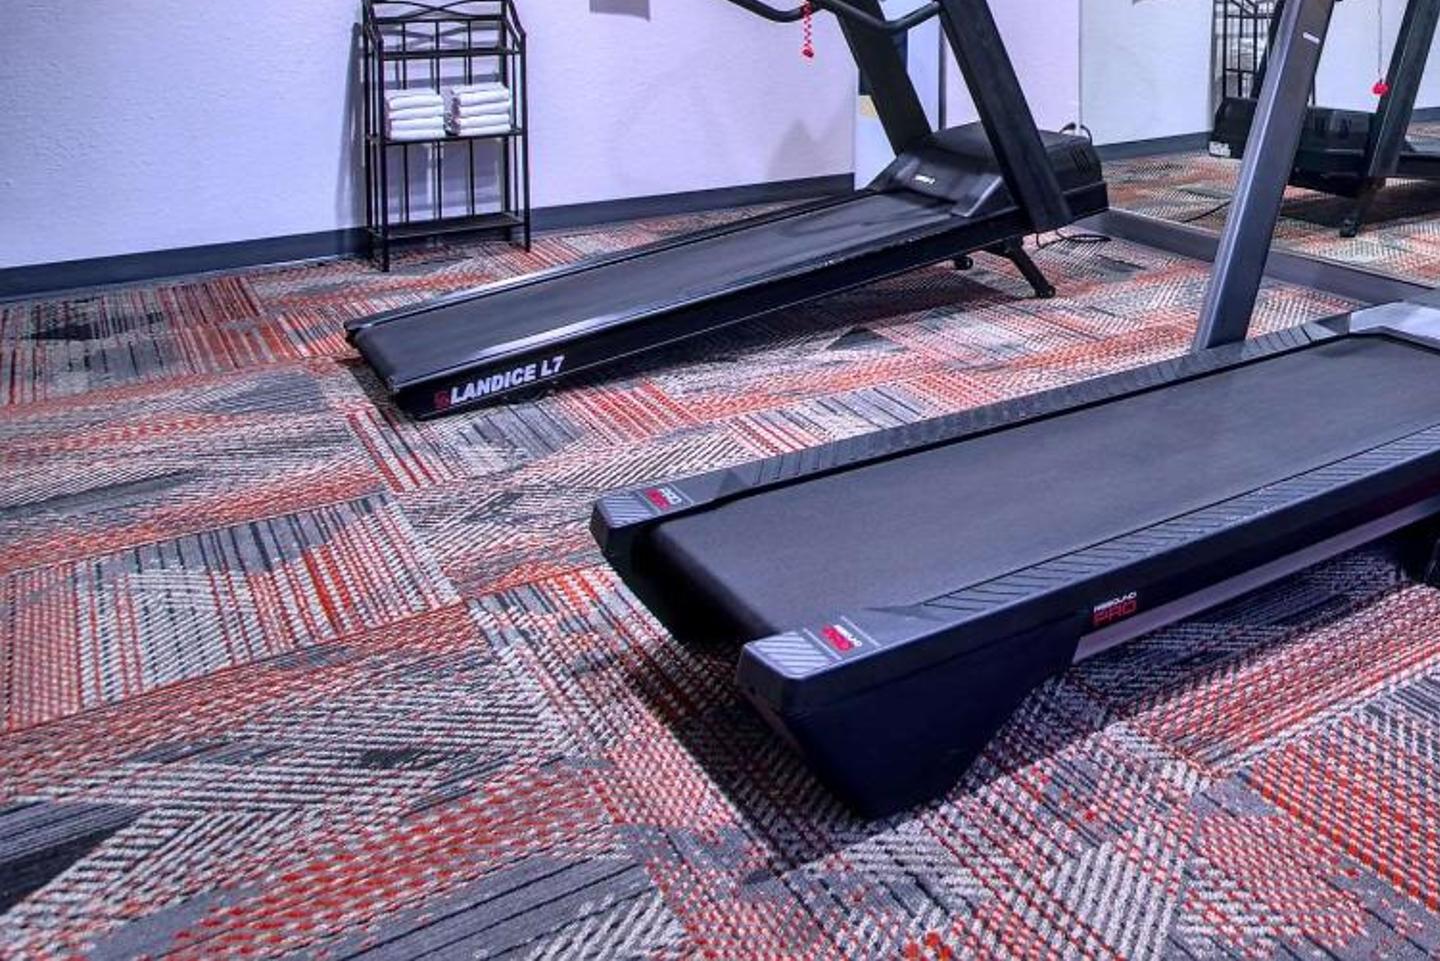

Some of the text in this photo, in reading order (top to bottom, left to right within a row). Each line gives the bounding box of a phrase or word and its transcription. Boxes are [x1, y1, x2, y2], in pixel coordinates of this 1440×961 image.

[451, 355, 565, 404] LANDICE L7
[1092, 600, 1137, 626] PRO
